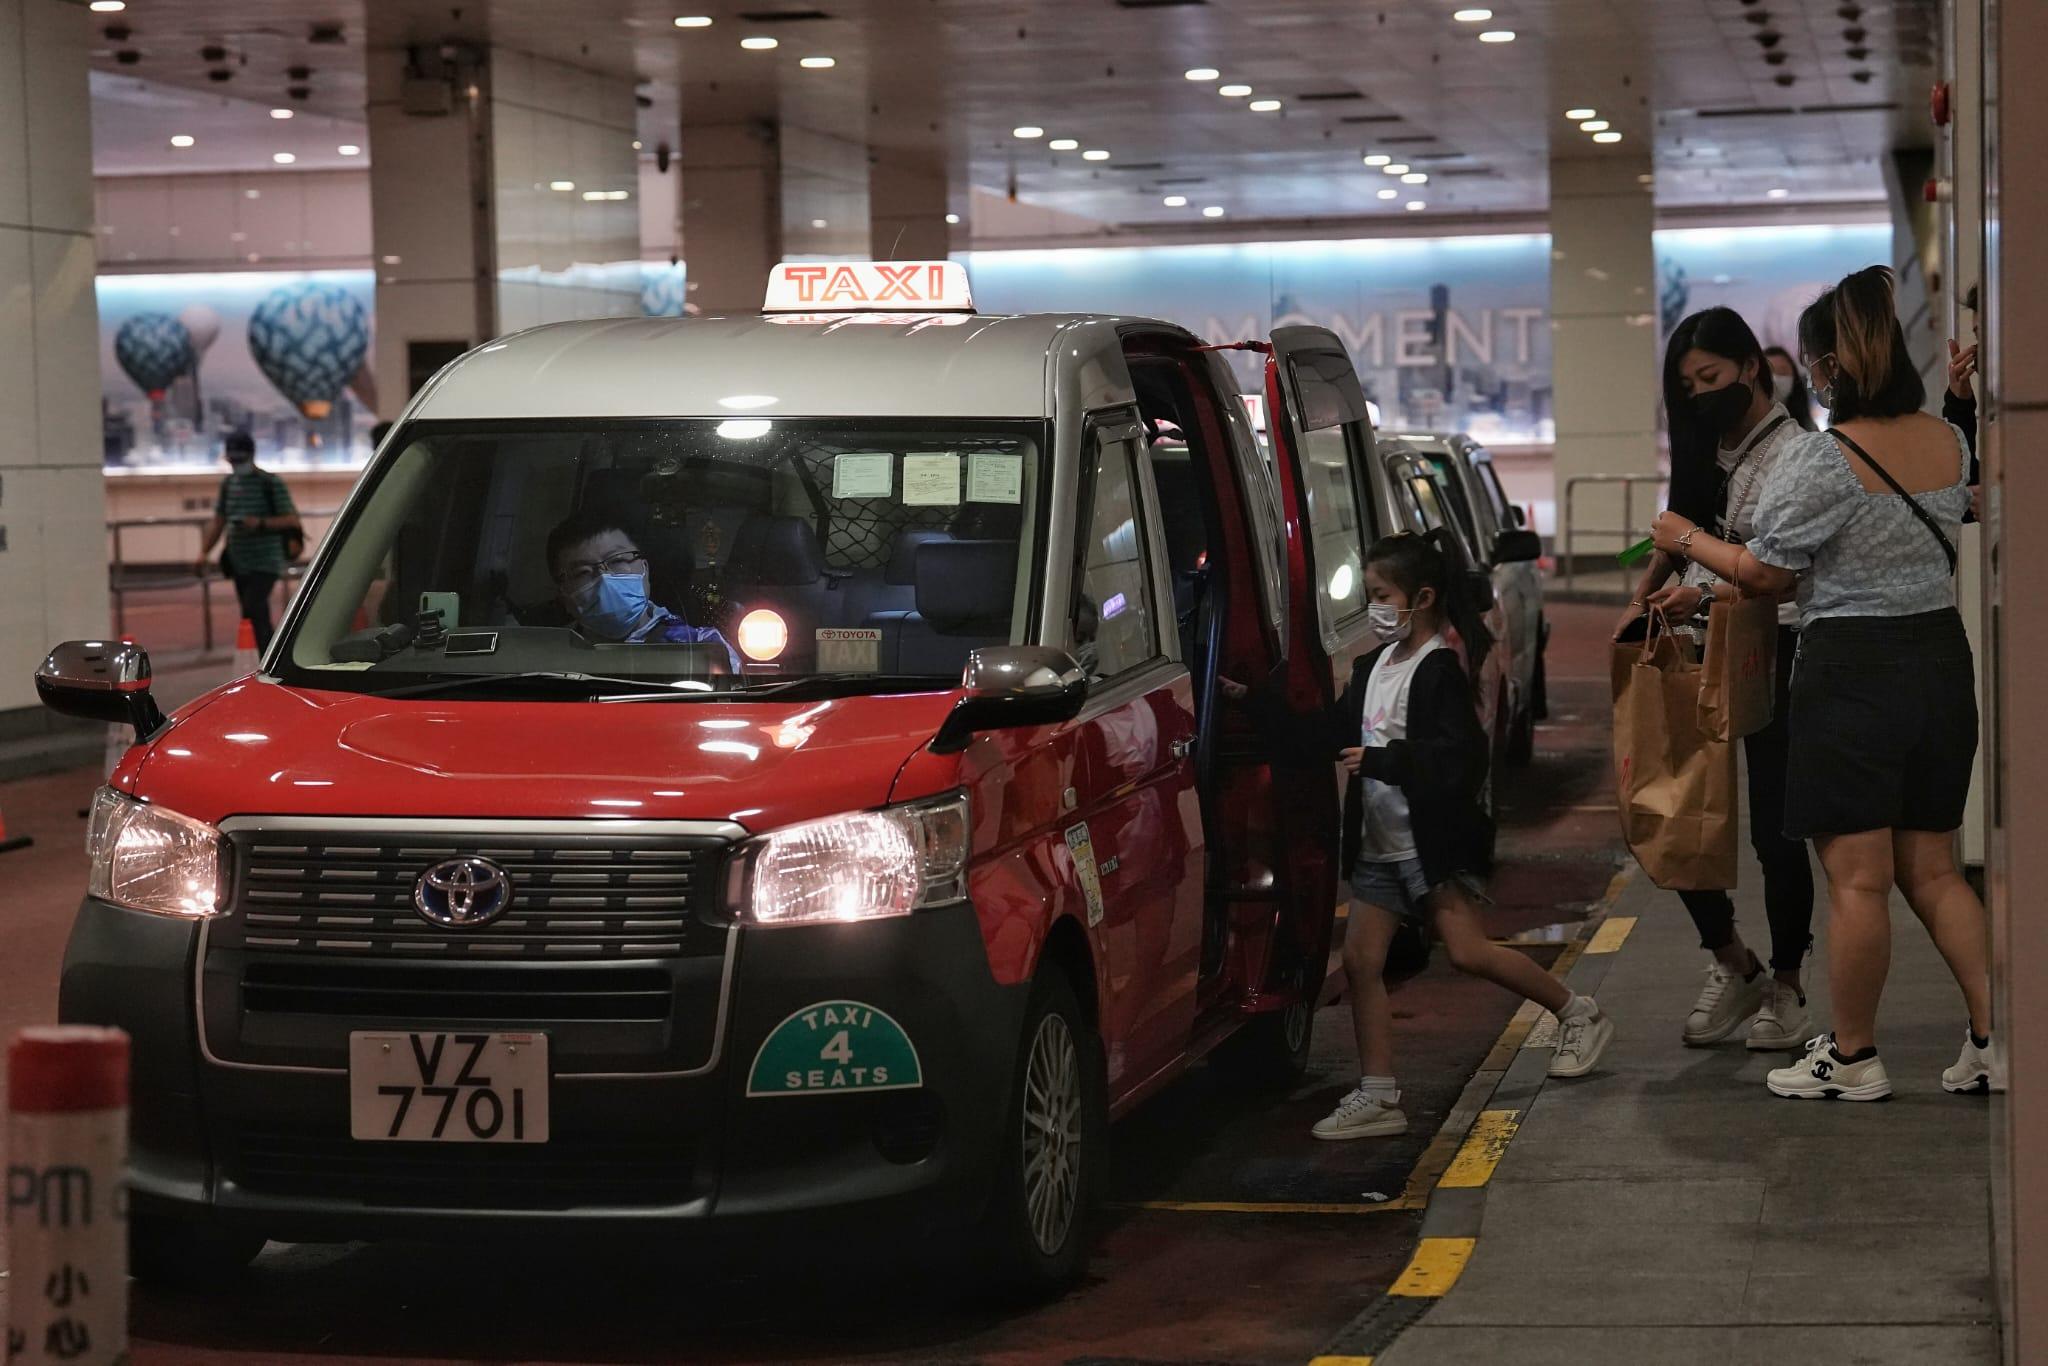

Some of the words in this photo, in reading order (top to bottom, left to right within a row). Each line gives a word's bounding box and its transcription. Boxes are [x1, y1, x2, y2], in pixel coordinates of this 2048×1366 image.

[785, 265, 944, 302] TAXI
[1205, 307, 1543, 369] MMENT
[837, 630, 877, 640] TOYOTA
[802, 1007, 873, 1031] TAXI
[409, 1034, 492, 1087] VZ
[820, 1030, 854, 1065] 4
[785, 1066, 889, 1089] SEATS
[377, 1085, 524, 1140] 7701
